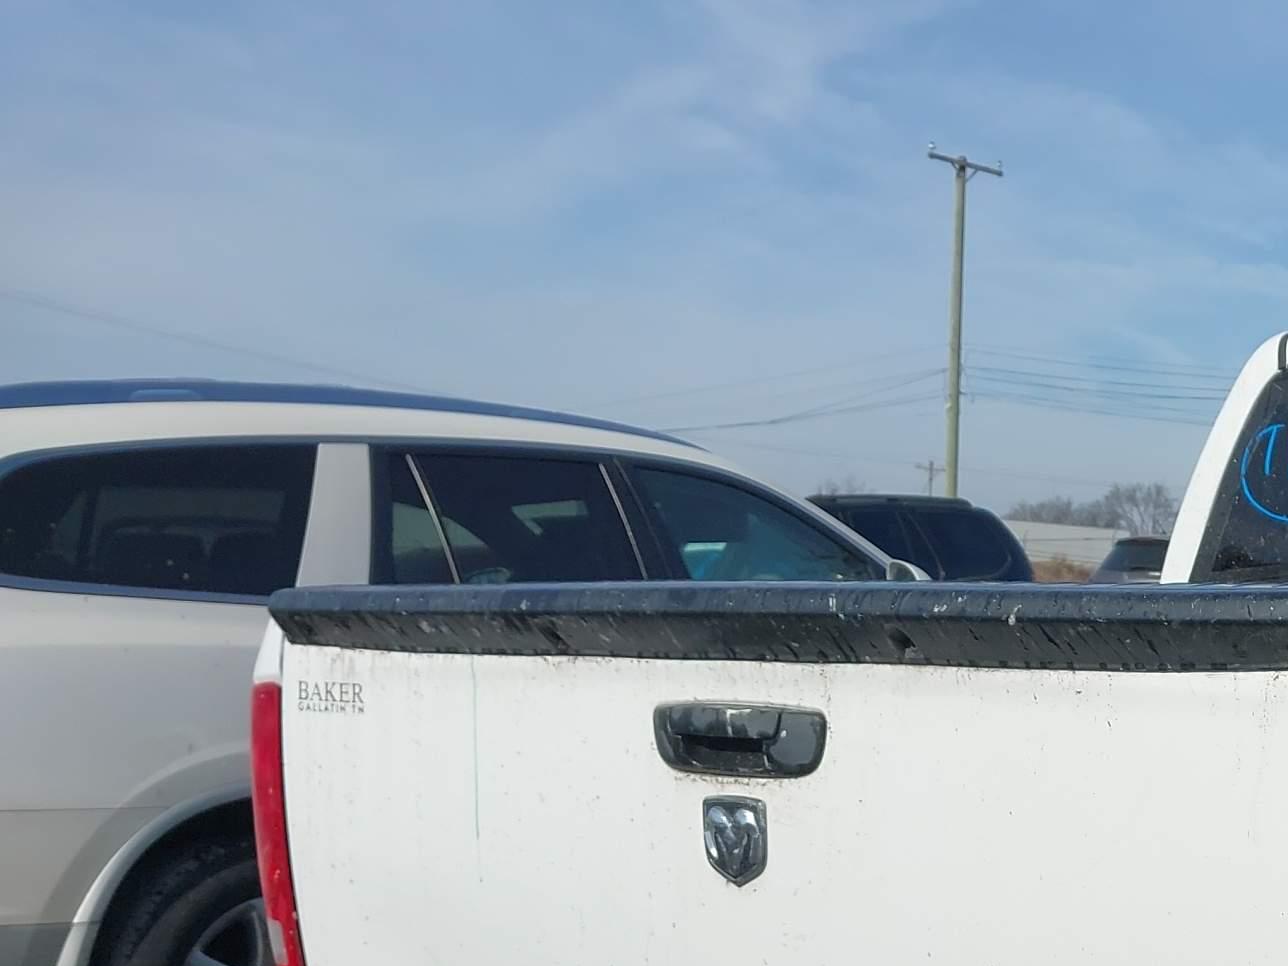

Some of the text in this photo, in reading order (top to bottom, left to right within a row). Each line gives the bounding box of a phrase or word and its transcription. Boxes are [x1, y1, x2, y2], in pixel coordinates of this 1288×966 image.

[298, 680, 364, 703] BAKER
[298, 701, 365, 713] GALLATIN TN
